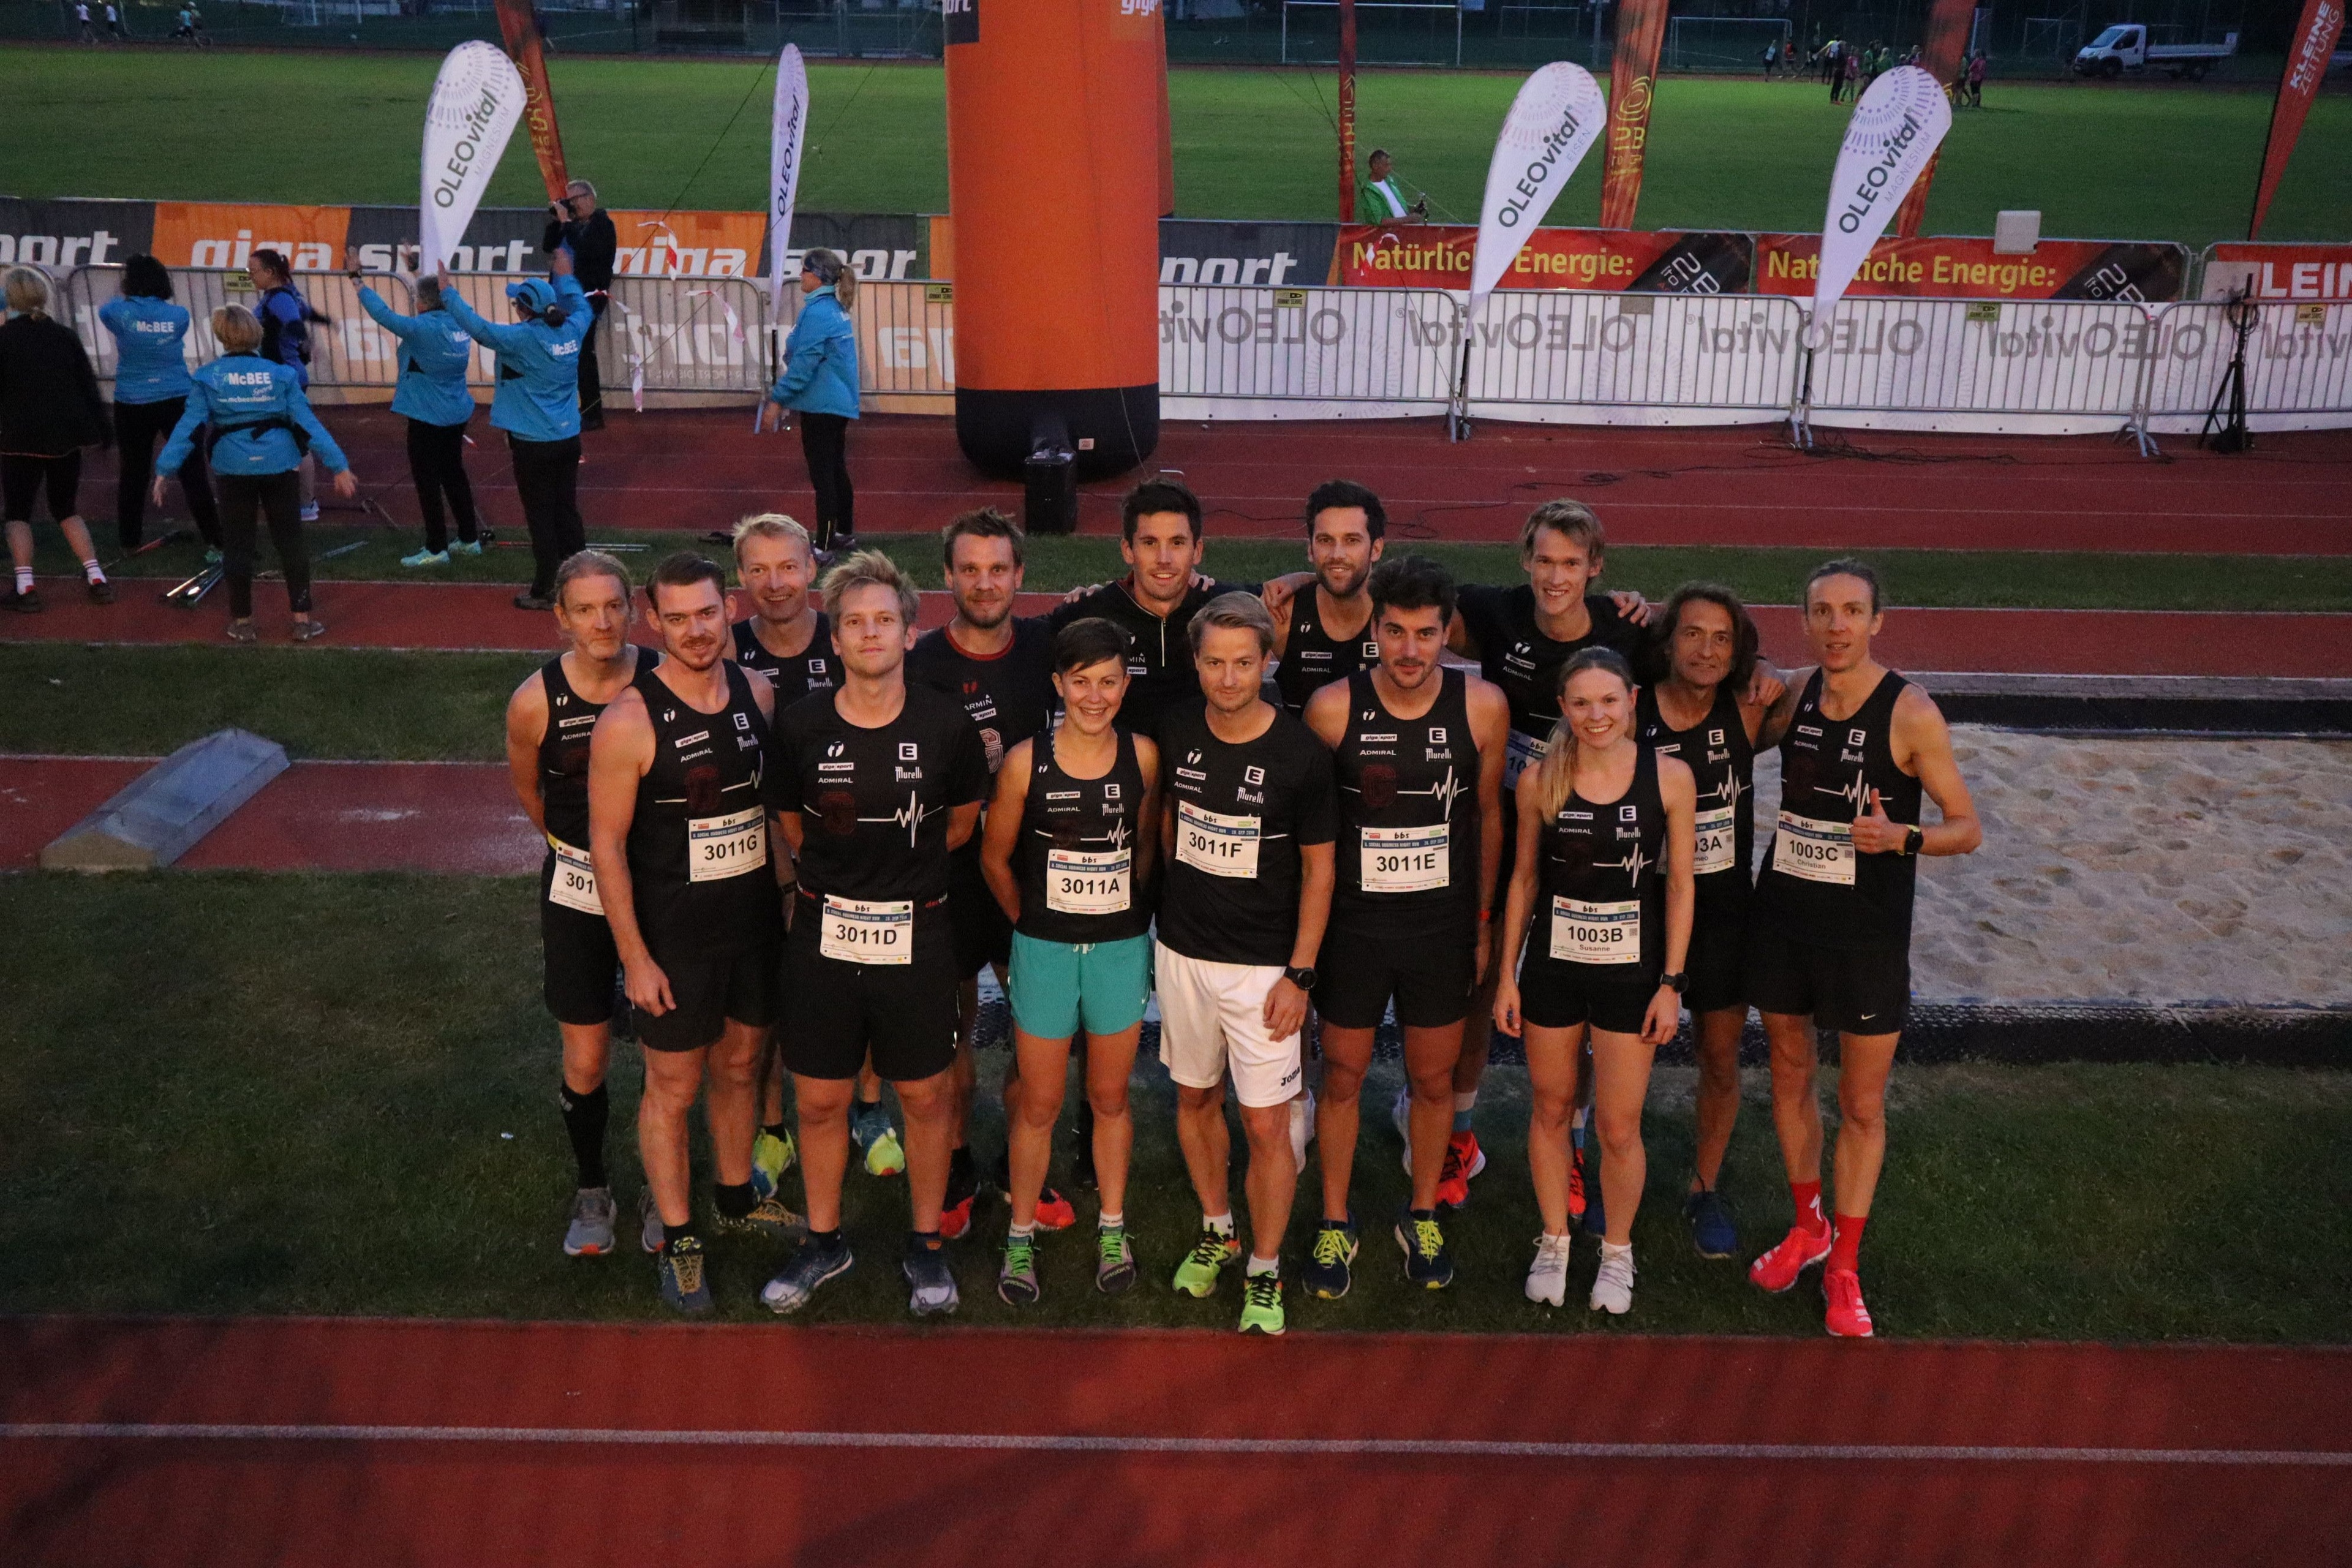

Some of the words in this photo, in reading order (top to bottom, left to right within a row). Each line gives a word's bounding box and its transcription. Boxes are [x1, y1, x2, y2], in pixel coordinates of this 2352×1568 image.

[2290, 0, 2331, 89] KLEINE
[2298, 8, 2340, 96] ZEITUNG
[1566, 129, 1591, 162] EISEN
[1884, 132, 1932, 203] MAGNESIUM
[1352, 242, 1476, 273] Natürlic
[1515, 246, 1634, 283] Energie:
[1768, 251, 1923, 282] Natiche
[1933, 255, 2057, 293] Energie:
[2260, 262, 2352, 298] LEI
[137, 320, 175, 333] McBEE
[552, 339, 579, 356] McBEE
[228, 372, 271, 385] McBEE
[1502, 665, 1532, 680] ADMIRAL
[807, 677, 832, 691] Murelli
[964, 698, 992, 711] ARMIN
[561, 730, 591, 741] ADMIRA
[736, 734, 759, 752] Murelli
[1793, 740, 1820, 751] ADMIRAL
[680, 747, 713, 763] ADMIRAL
[1425, 747, 1452, 762] Murelli
[1708, 747, 1730, 764] Murelli
[1840, 748, 1864, 763] Murelli
[895, 766, 922, 783] Murelli
[1174, 780, 1202, 794] ADMIRAL
[1237, 786, 1264, 805] Murelli
[1102, 803, 1125, 816] Murelli
[723, 818, 736, 827] bbs
[1204, 814, 1218, 823] bbs
[1558, 826, 1593, 835] ADMIRAL
[1616, 826, 1642, 841] Murelli
[704, 834, 757, 861] 3011G
[1189, 832, 1242, 858] 3011F
[1790, 840, 1838, 861] 1003C
[1376, 853, 1435, 872] 3011E
[1797, 859, 1826, 869] Christian
[566, 872, 593, 894] 301
[1061, 878, 1120, 895] 3011A
[835, 924, 897, 944] 3011D
[1568, 925, 1623, 943] 1003B
[1281, 1066, 1301, 1087] Joma
